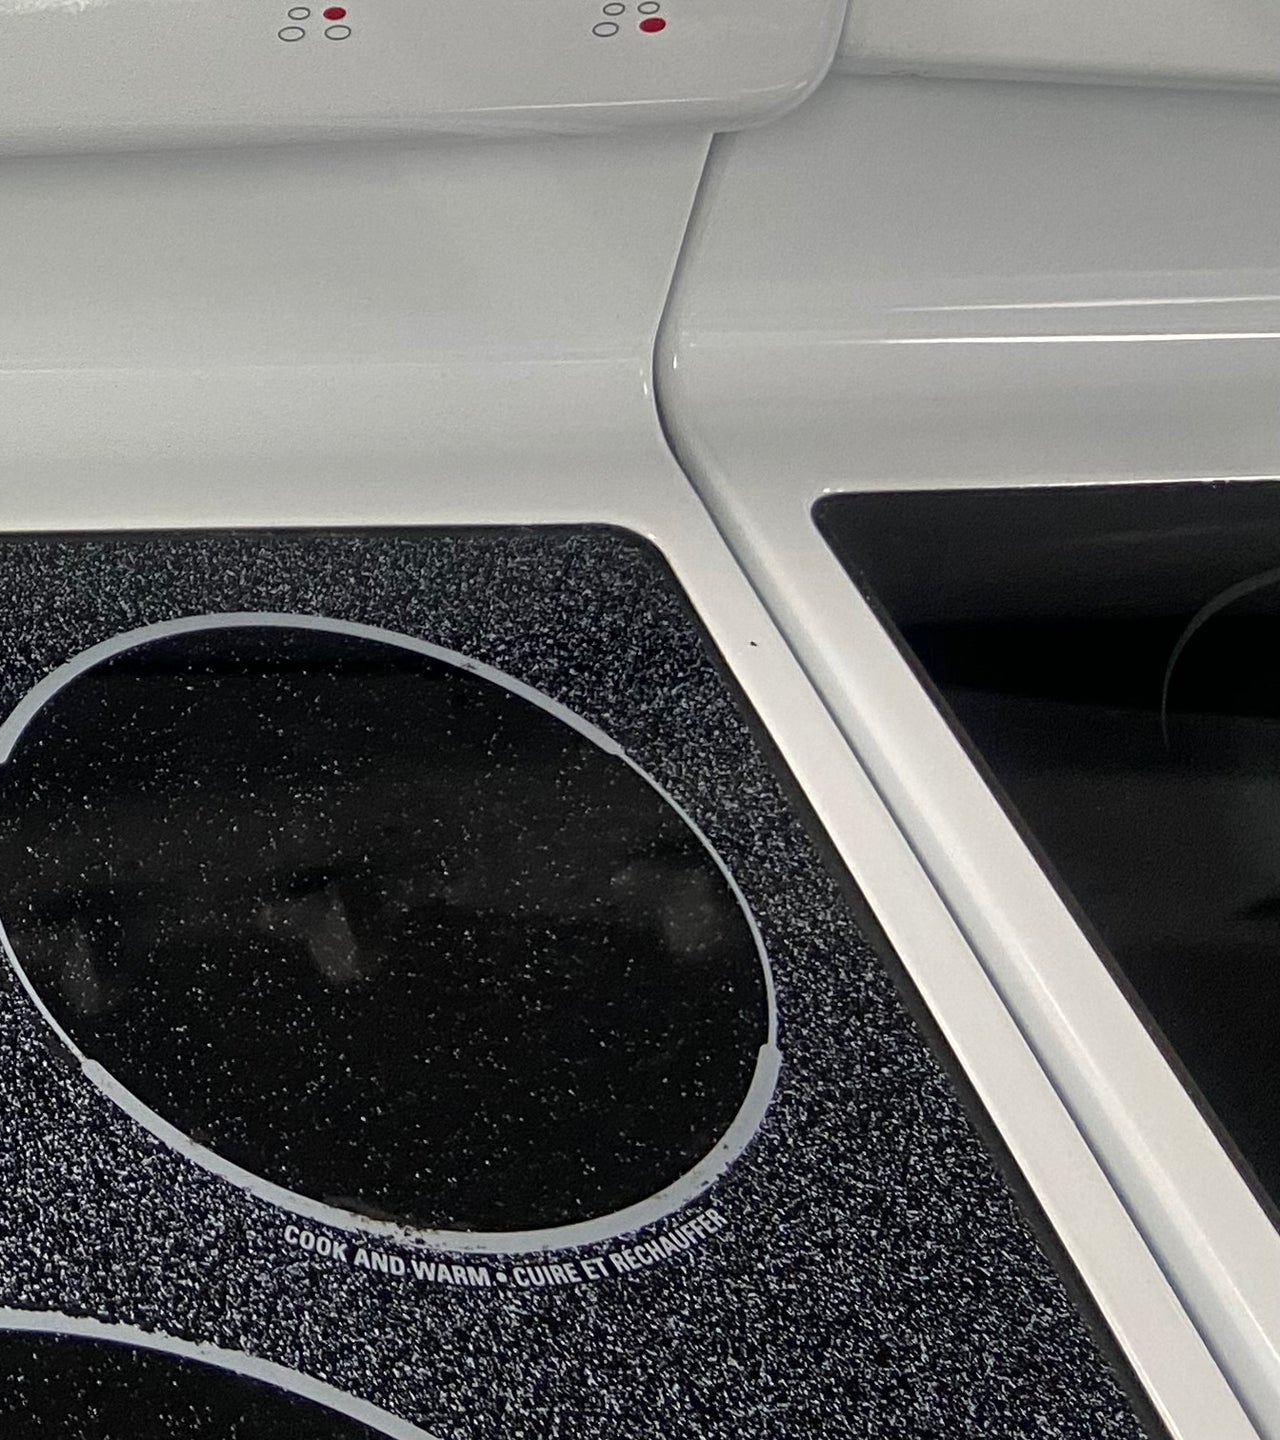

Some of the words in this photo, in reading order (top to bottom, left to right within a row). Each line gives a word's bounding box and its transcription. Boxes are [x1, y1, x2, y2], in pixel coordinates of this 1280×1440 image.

[283, 1224, 347, 1260] COOK
[353, 1248, 406, 1276] AND
[412, 1260, 490, 1287] WARM
[513, 1264, 582, 1287] CUIRE
[586, 1257, 610, 1280] ET
